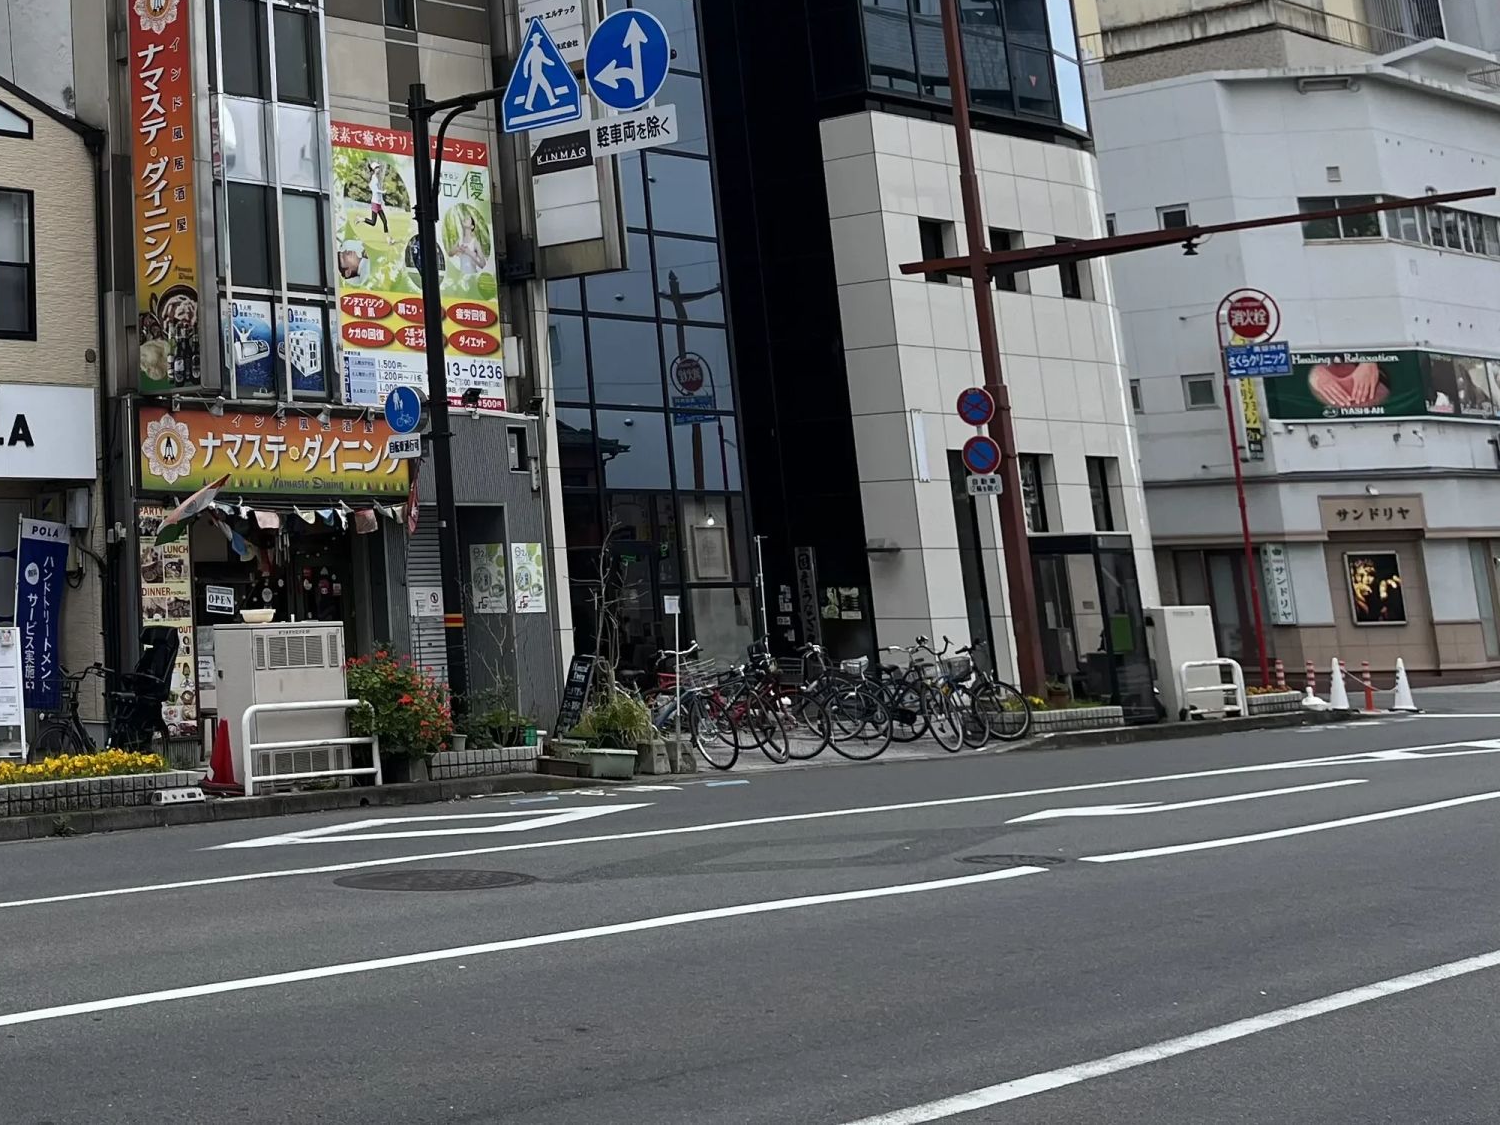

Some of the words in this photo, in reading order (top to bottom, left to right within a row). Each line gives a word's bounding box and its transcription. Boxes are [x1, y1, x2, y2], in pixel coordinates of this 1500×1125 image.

[545, 6, 576, 20] エルテック
[597, 115, 670, 148] 軽車両を除く
[536, 146, 587, 165] KINMAQ
[455, 307, 487, 322] 疲労回復
[1230, 309, 1268, 327] 消火栓
[348, 328, 385, 341] ケガの回復
[458, 335, 487, 348] ダイエット
[1228, 353, 1286, 369] さくらクリニック
[1291, 354, 1331, 366] Healing
[1343, 353, 1399, 364] Relaxation
[1336, 507, 1410, 521] サンドリヤ
[32, 525, 60, 538] POLA
[163, 545, 189, 555] LUNCH
[142, 587, 171, 596] DINNER
[1273, 565, 1292, 620] サンドリヤ
[208, 595, 232, 605] OPEN
[41, 556, 55, 693] ハンドトリートメント
